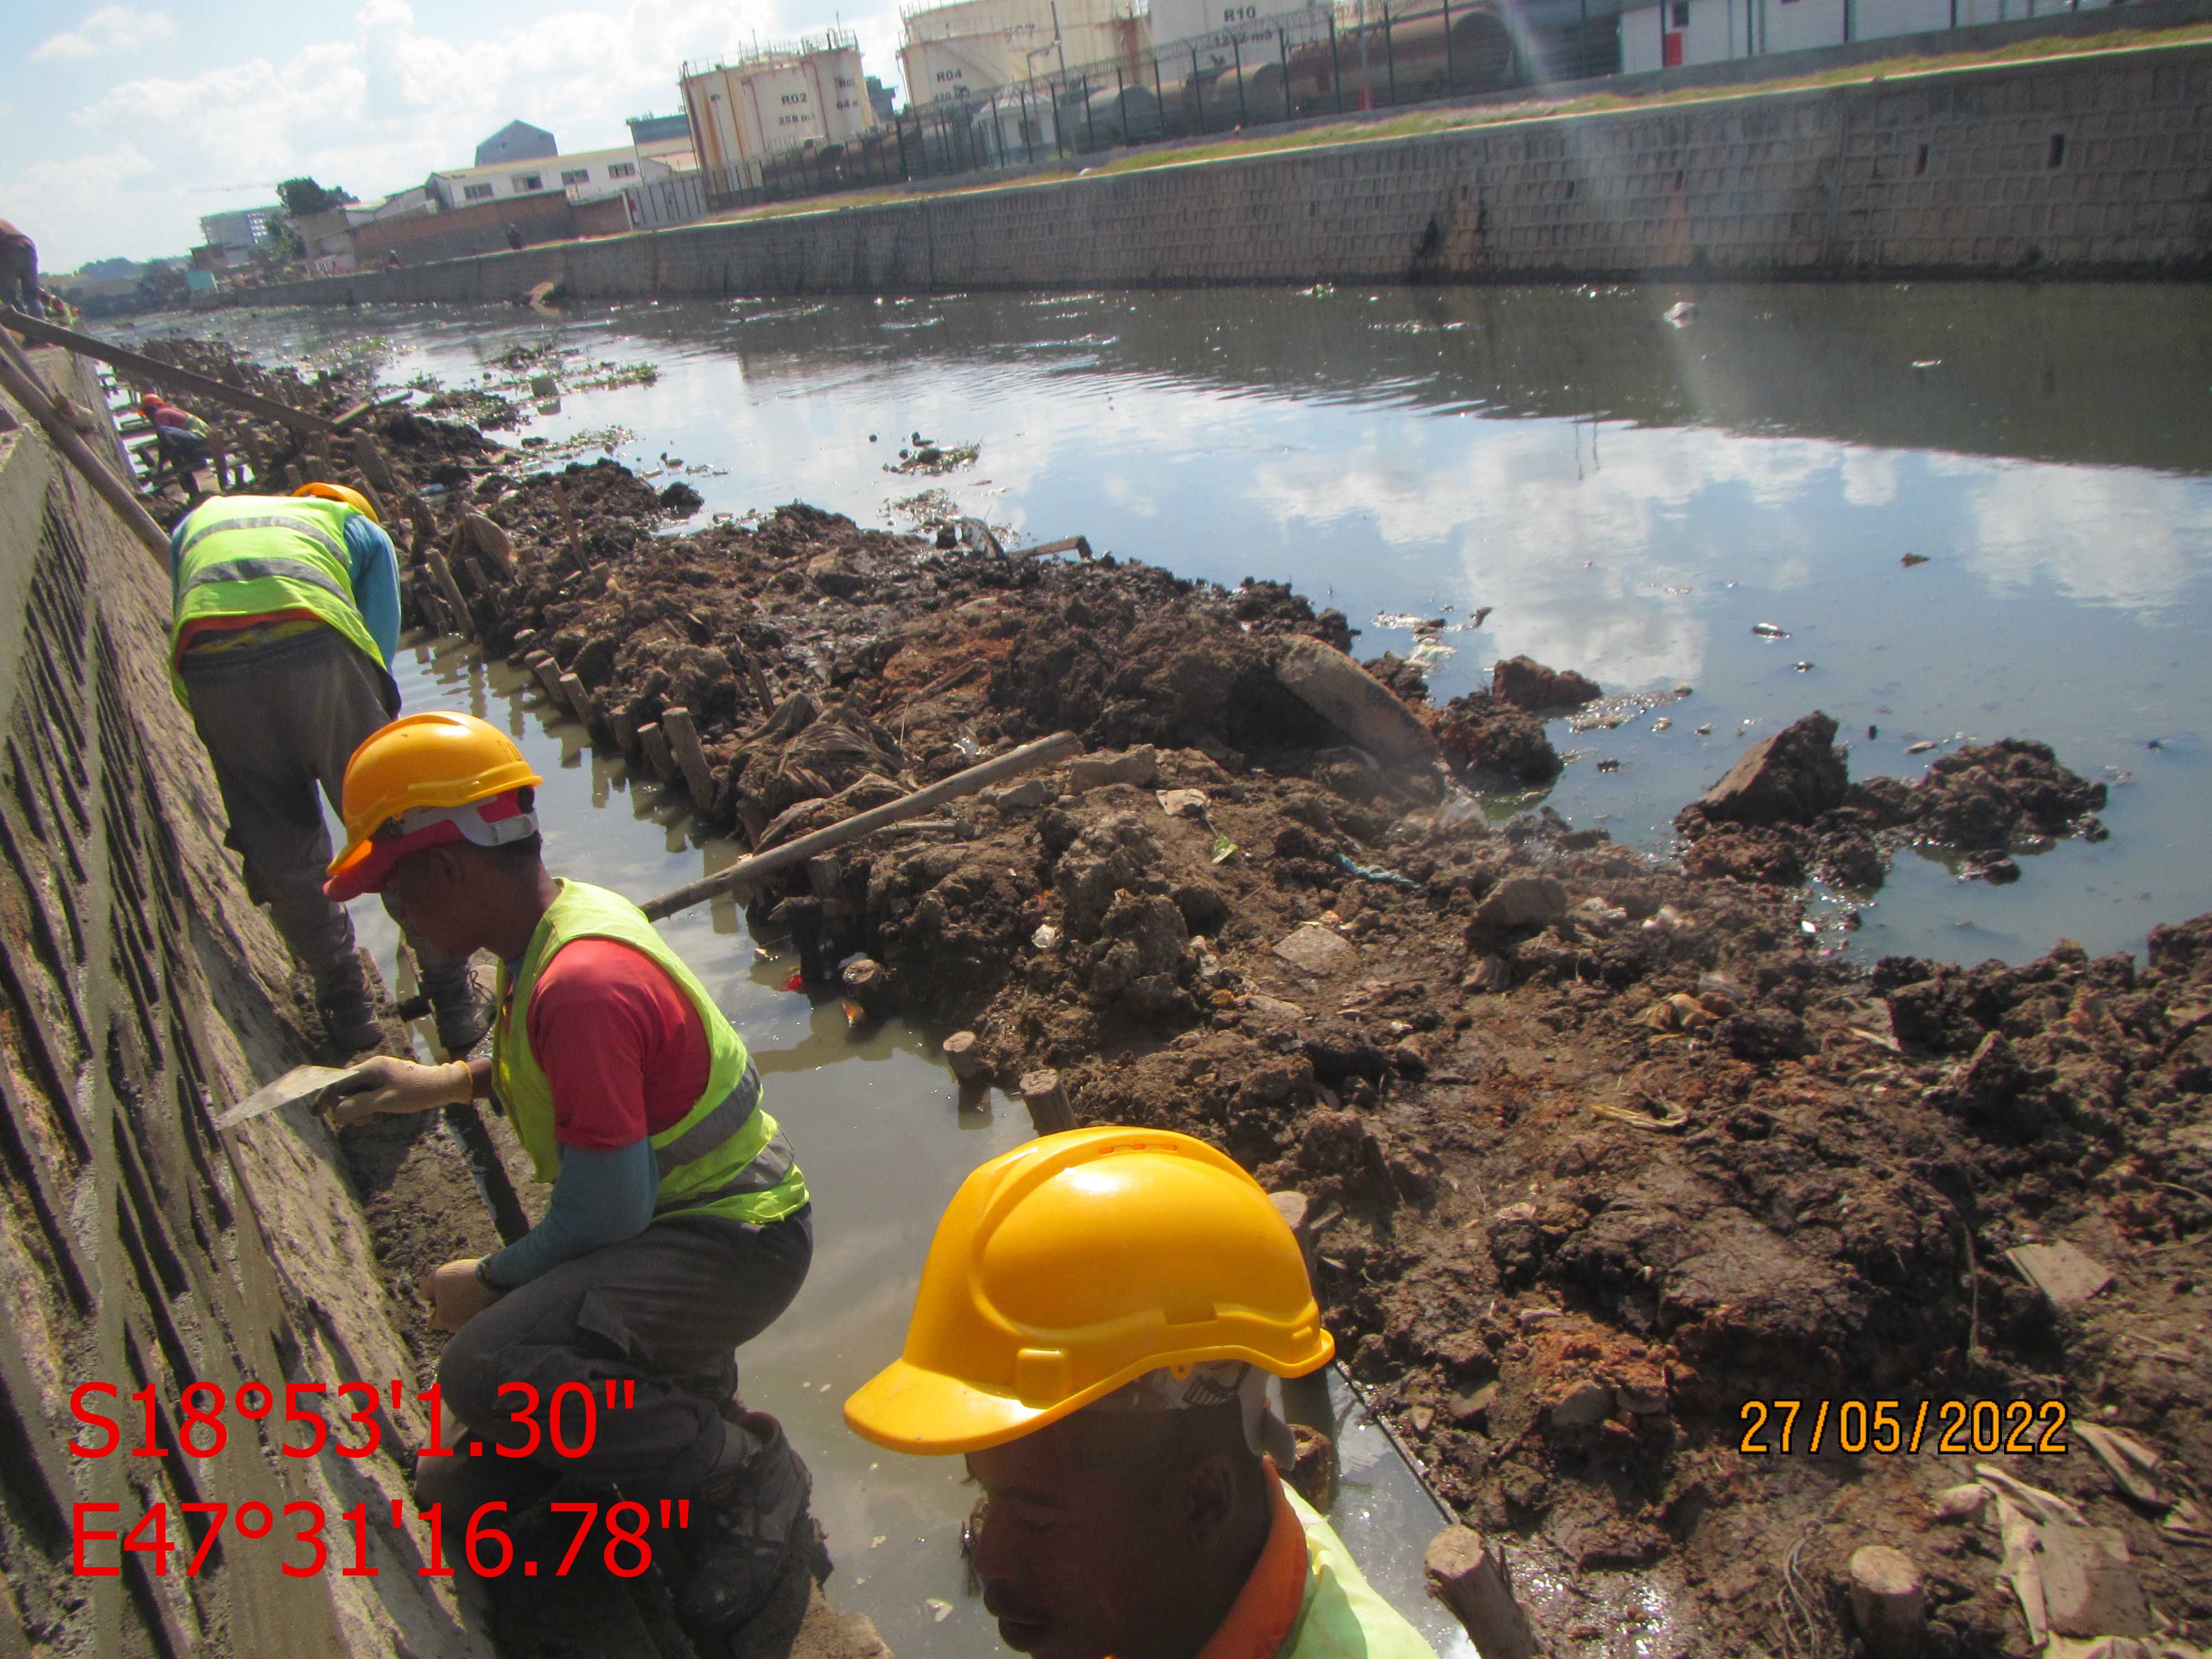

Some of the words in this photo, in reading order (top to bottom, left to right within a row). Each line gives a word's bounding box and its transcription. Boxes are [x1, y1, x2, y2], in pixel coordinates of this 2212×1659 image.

[1223, 5, 1256, 22] R10
[937, 69, 962, 82] R04
[781, 93, 808, 105] R02
